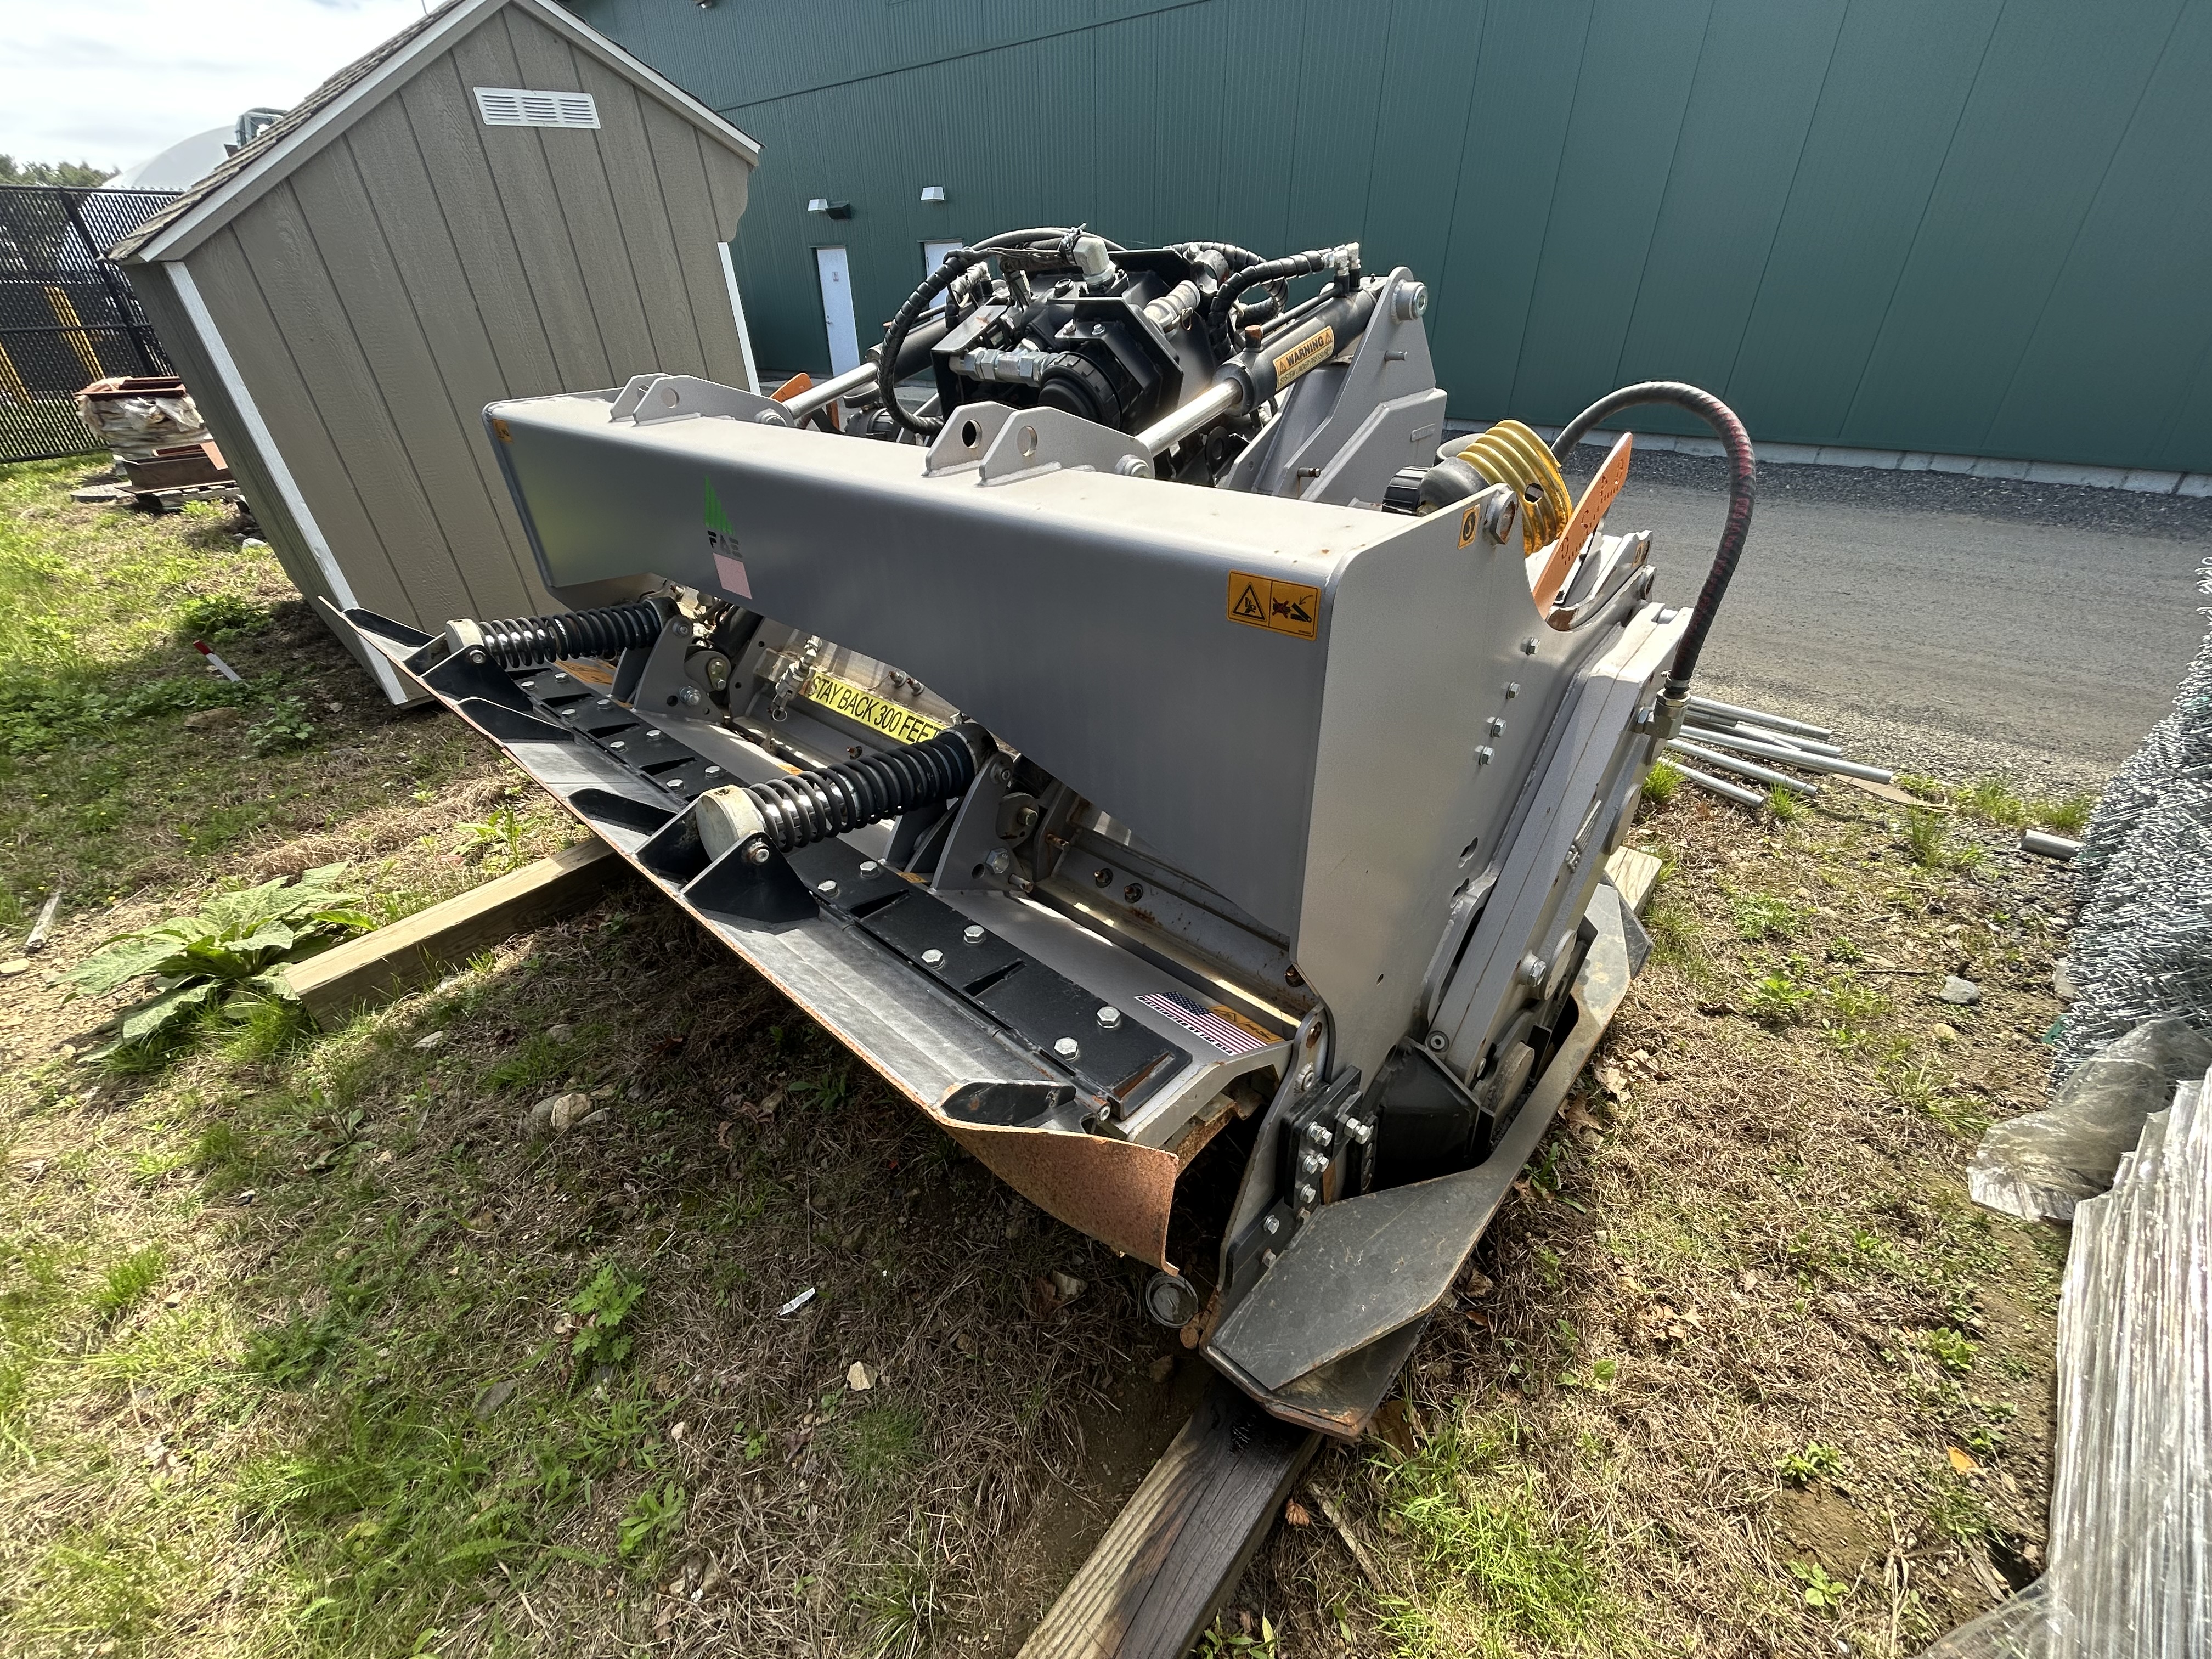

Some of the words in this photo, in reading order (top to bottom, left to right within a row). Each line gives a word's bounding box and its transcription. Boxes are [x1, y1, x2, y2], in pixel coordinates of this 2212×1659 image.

[1286, 336, 1324, 366] WARNING
[707, 529, 743, 558] FAE
[809, 676, 844, 704] STAY
[837, 688, 880, 722] BACK
[874, 704, 902, 732] 300
[898, 715, 942, 743] FEET
[1137, 996, 1189, 1026] DISTRIBUTED
[1199, 1034, 1216, 1043] FAE
[1215, 1043, 1233, 1054] USA
